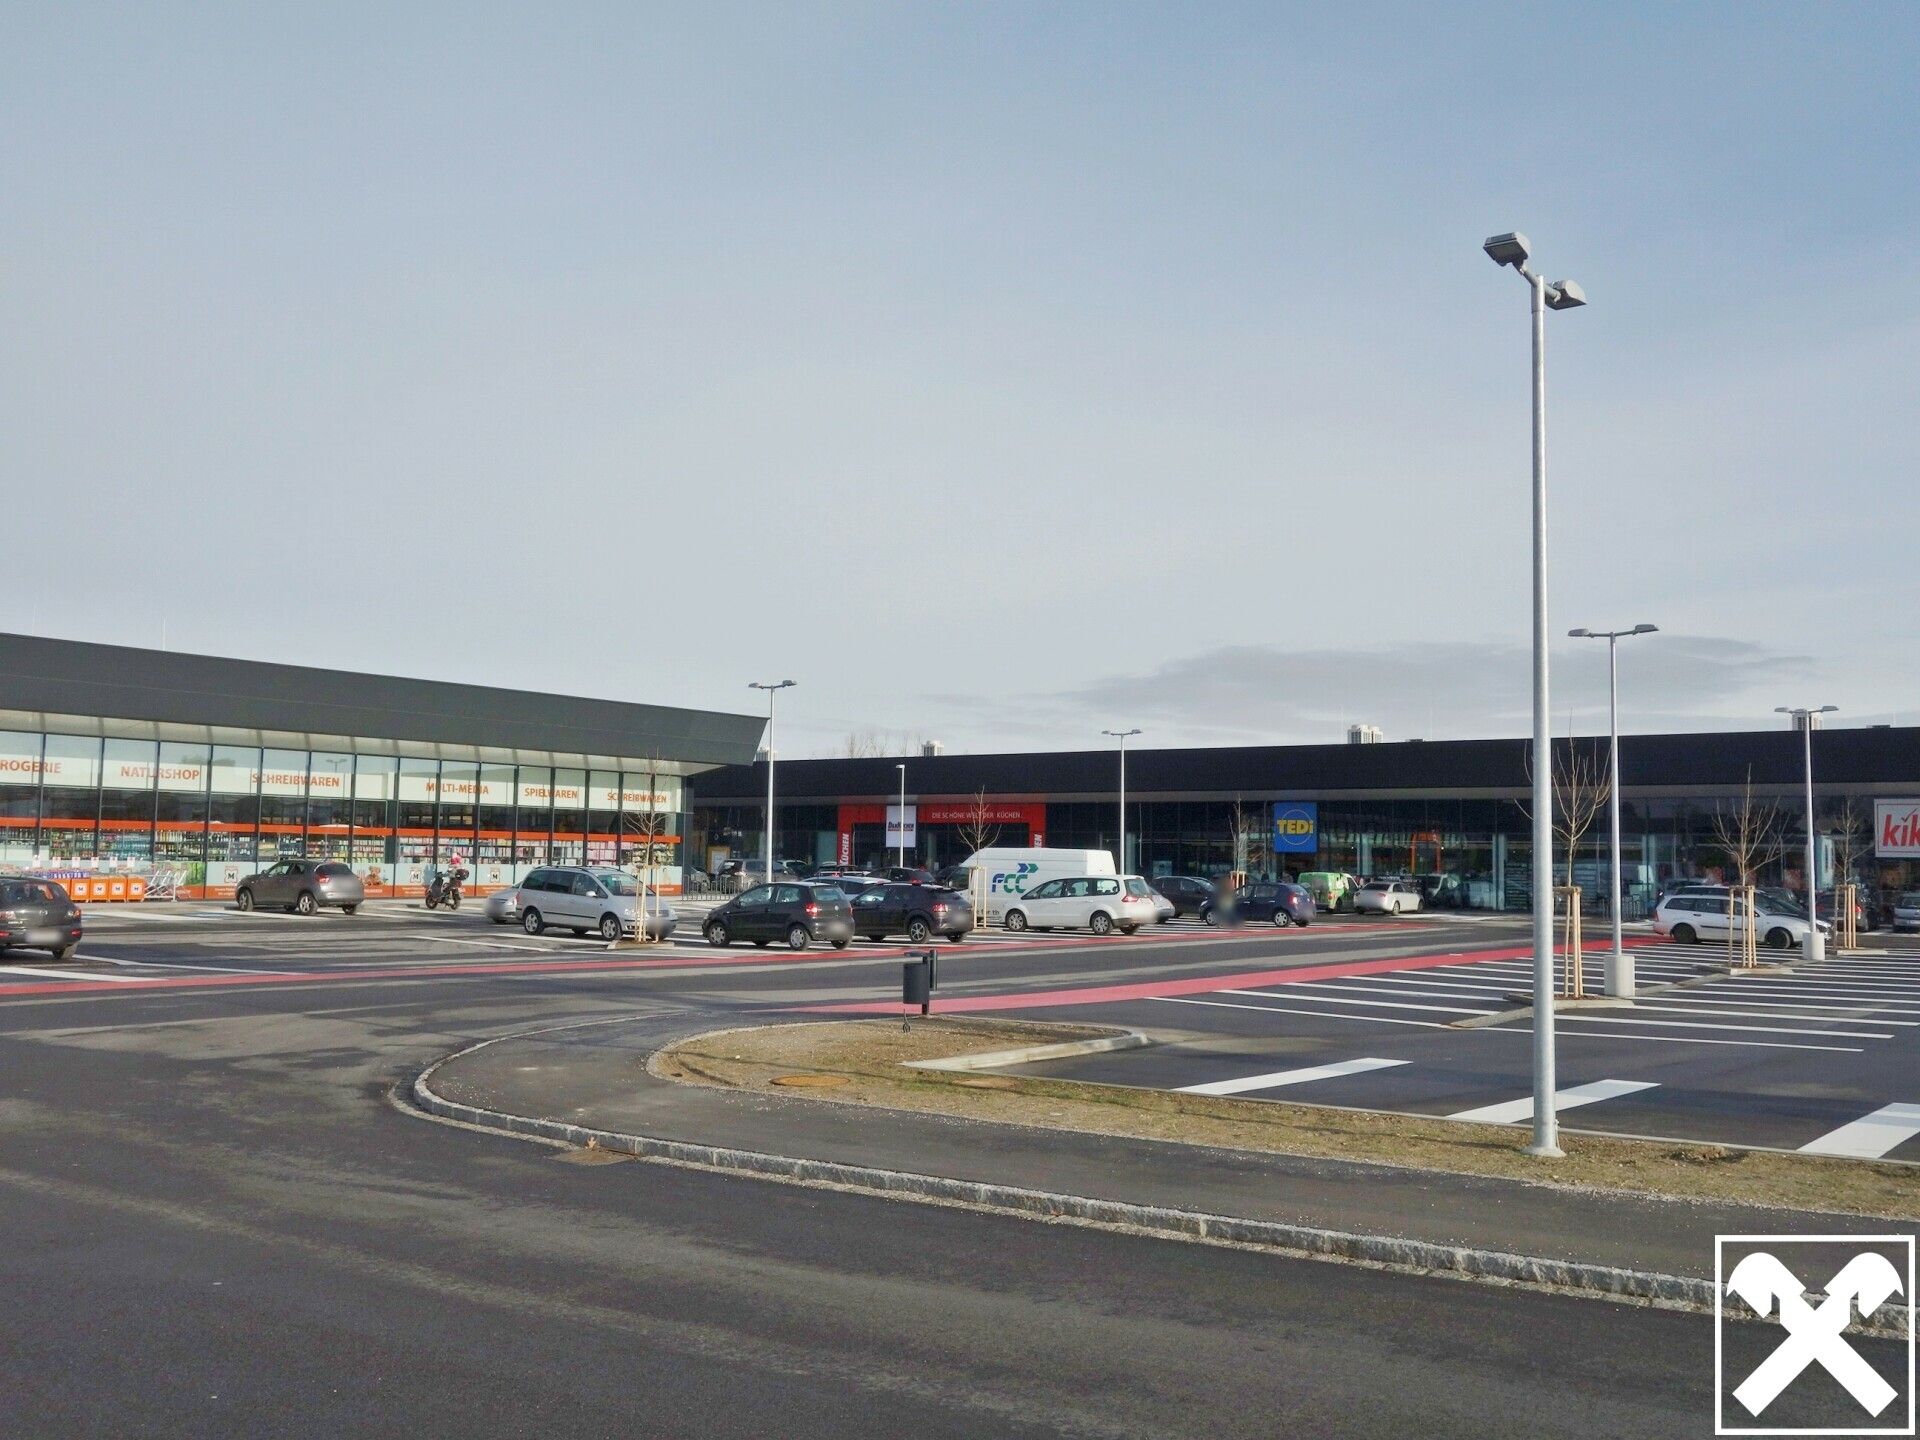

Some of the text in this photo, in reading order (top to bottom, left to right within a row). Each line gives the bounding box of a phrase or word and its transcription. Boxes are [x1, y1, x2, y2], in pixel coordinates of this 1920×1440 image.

[121, 766, 199, 780] NATURSHOP
[252, 773, 340, 787] SCHREIBWAREN
[426, 783, 489, 794] MLTI-MEDIA
[607, 792, 667, 803] SCREIBWAEN
[992, 873, 1028, 894] FCC
